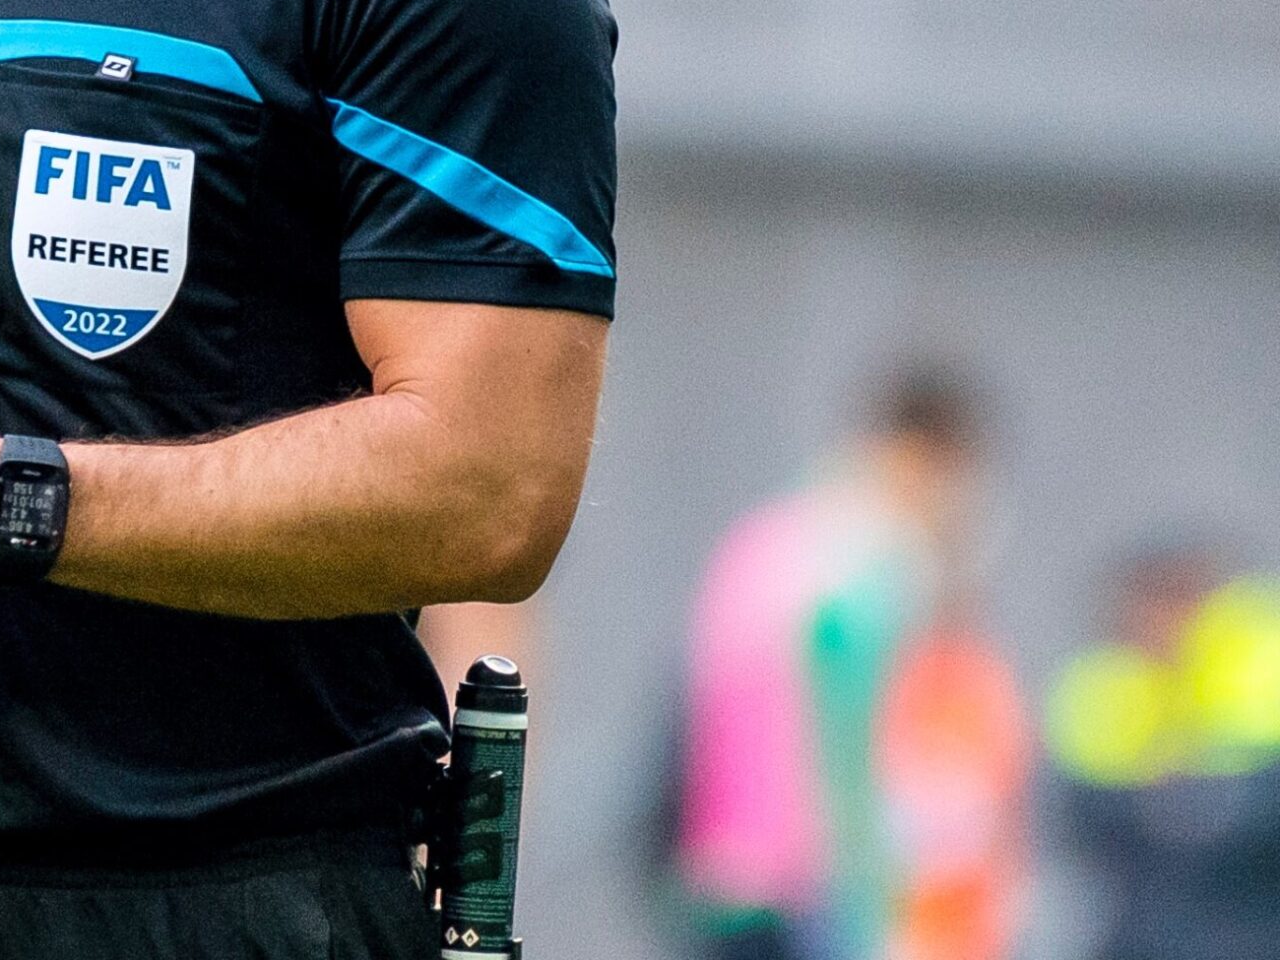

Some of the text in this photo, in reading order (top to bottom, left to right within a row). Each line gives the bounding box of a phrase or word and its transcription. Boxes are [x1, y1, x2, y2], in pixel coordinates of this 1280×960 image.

[34, 145, 171, 211] FIFA
[27, 233, 169, 274] REFEREE
[62, 309, 127, 336] 2022
